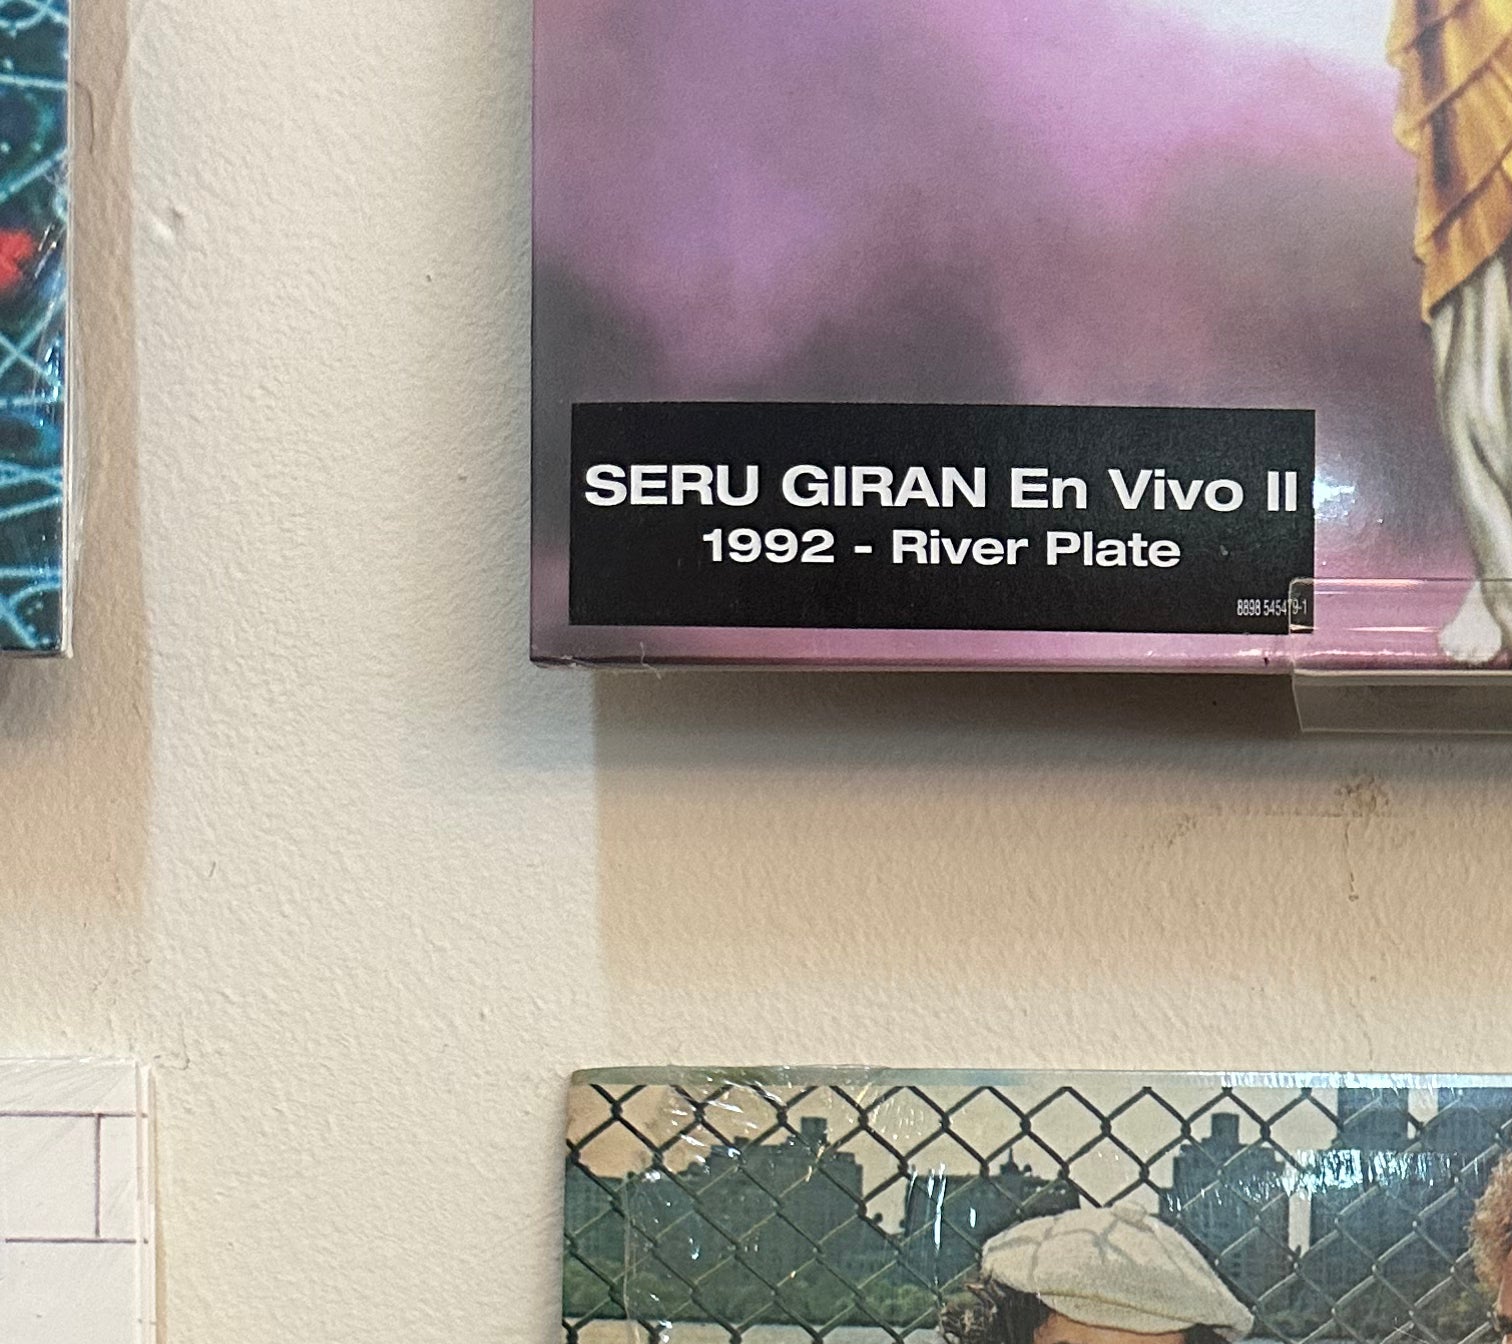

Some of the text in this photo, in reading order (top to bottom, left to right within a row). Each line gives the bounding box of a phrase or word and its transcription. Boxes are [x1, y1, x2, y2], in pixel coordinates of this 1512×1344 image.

[584, 463, 1298, 514] SERU GIRAN En Vivo II
[702, 529, 836, 564] 1992
[891, 530, 1028, 567] River
[1045, 531, 1181, 569] Plate
[1236, 598, 1262, 617] 8898
